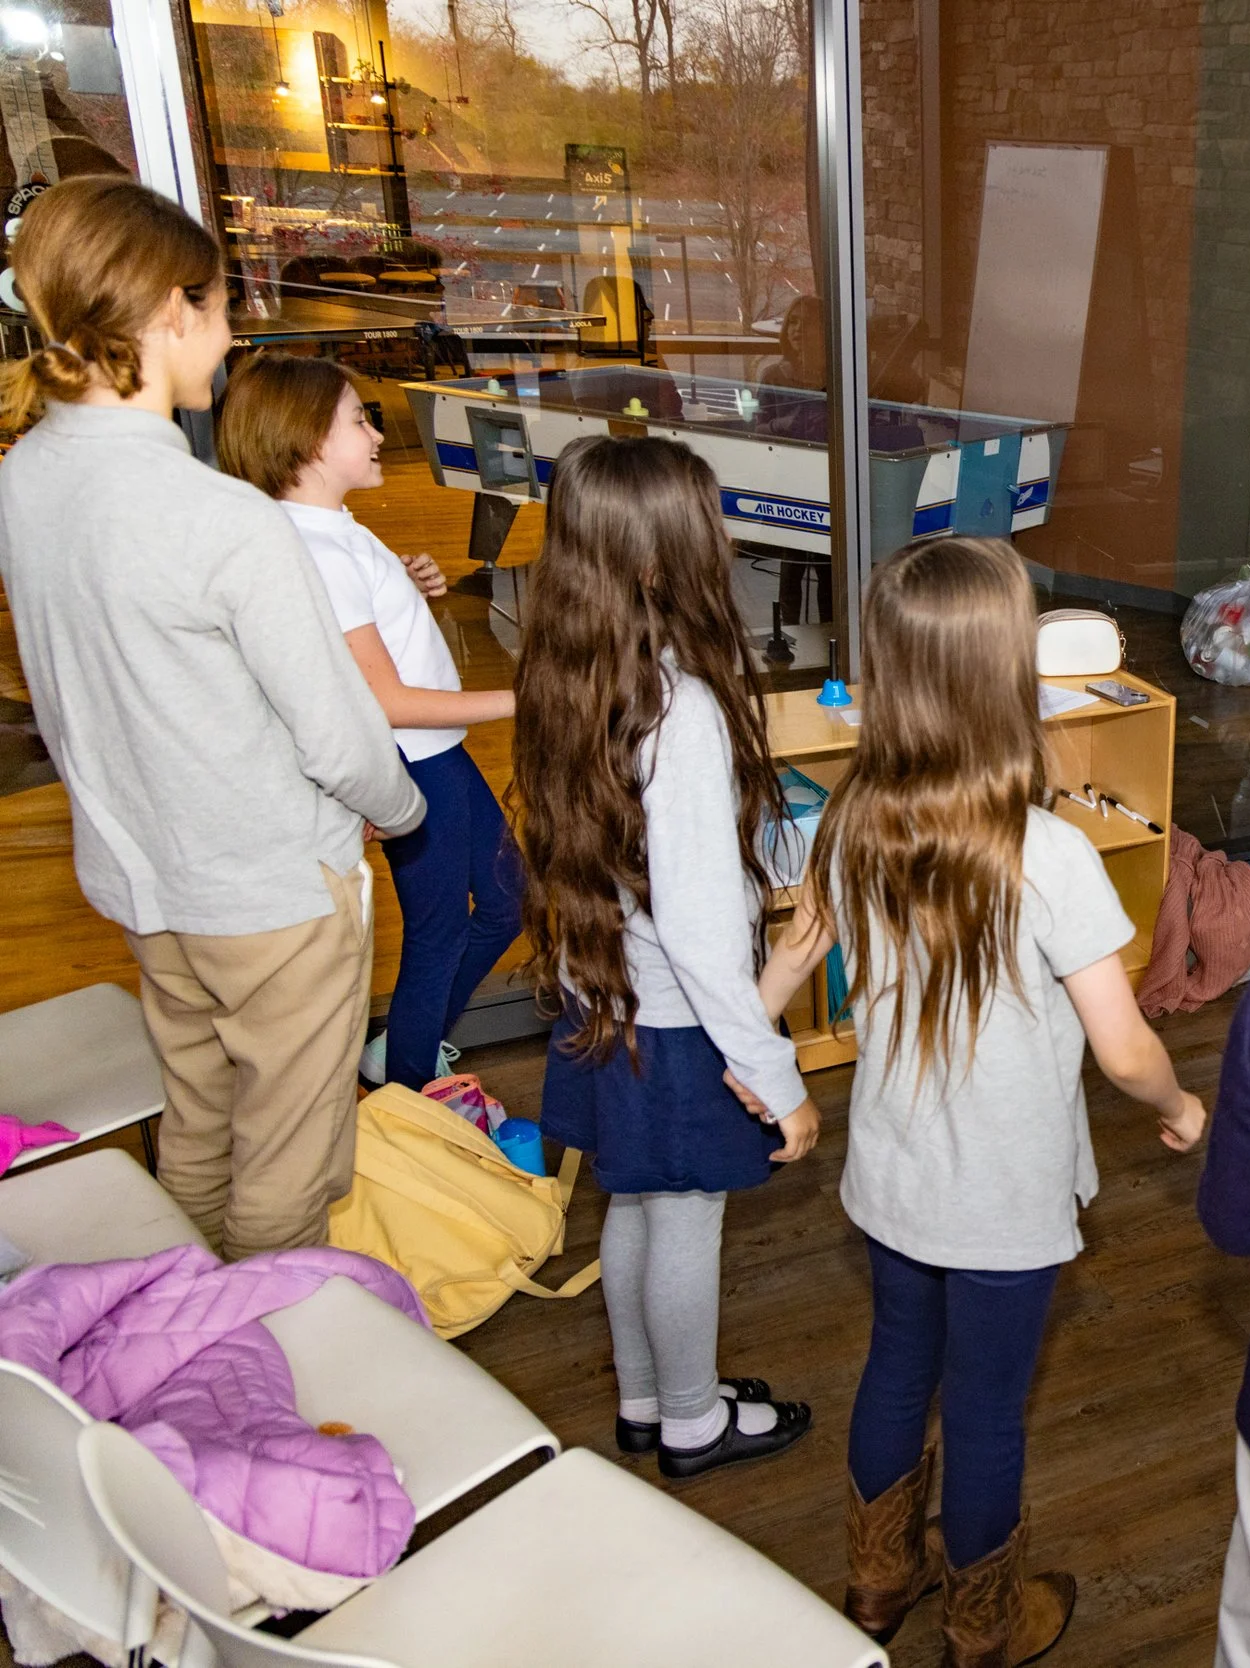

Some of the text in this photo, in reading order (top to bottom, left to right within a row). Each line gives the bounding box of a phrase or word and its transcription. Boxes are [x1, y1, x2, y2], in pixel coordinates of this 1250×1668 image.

[364, 331, 382, 339] TOUR
[754, 503, 824, 523] AIR HOCKEY
